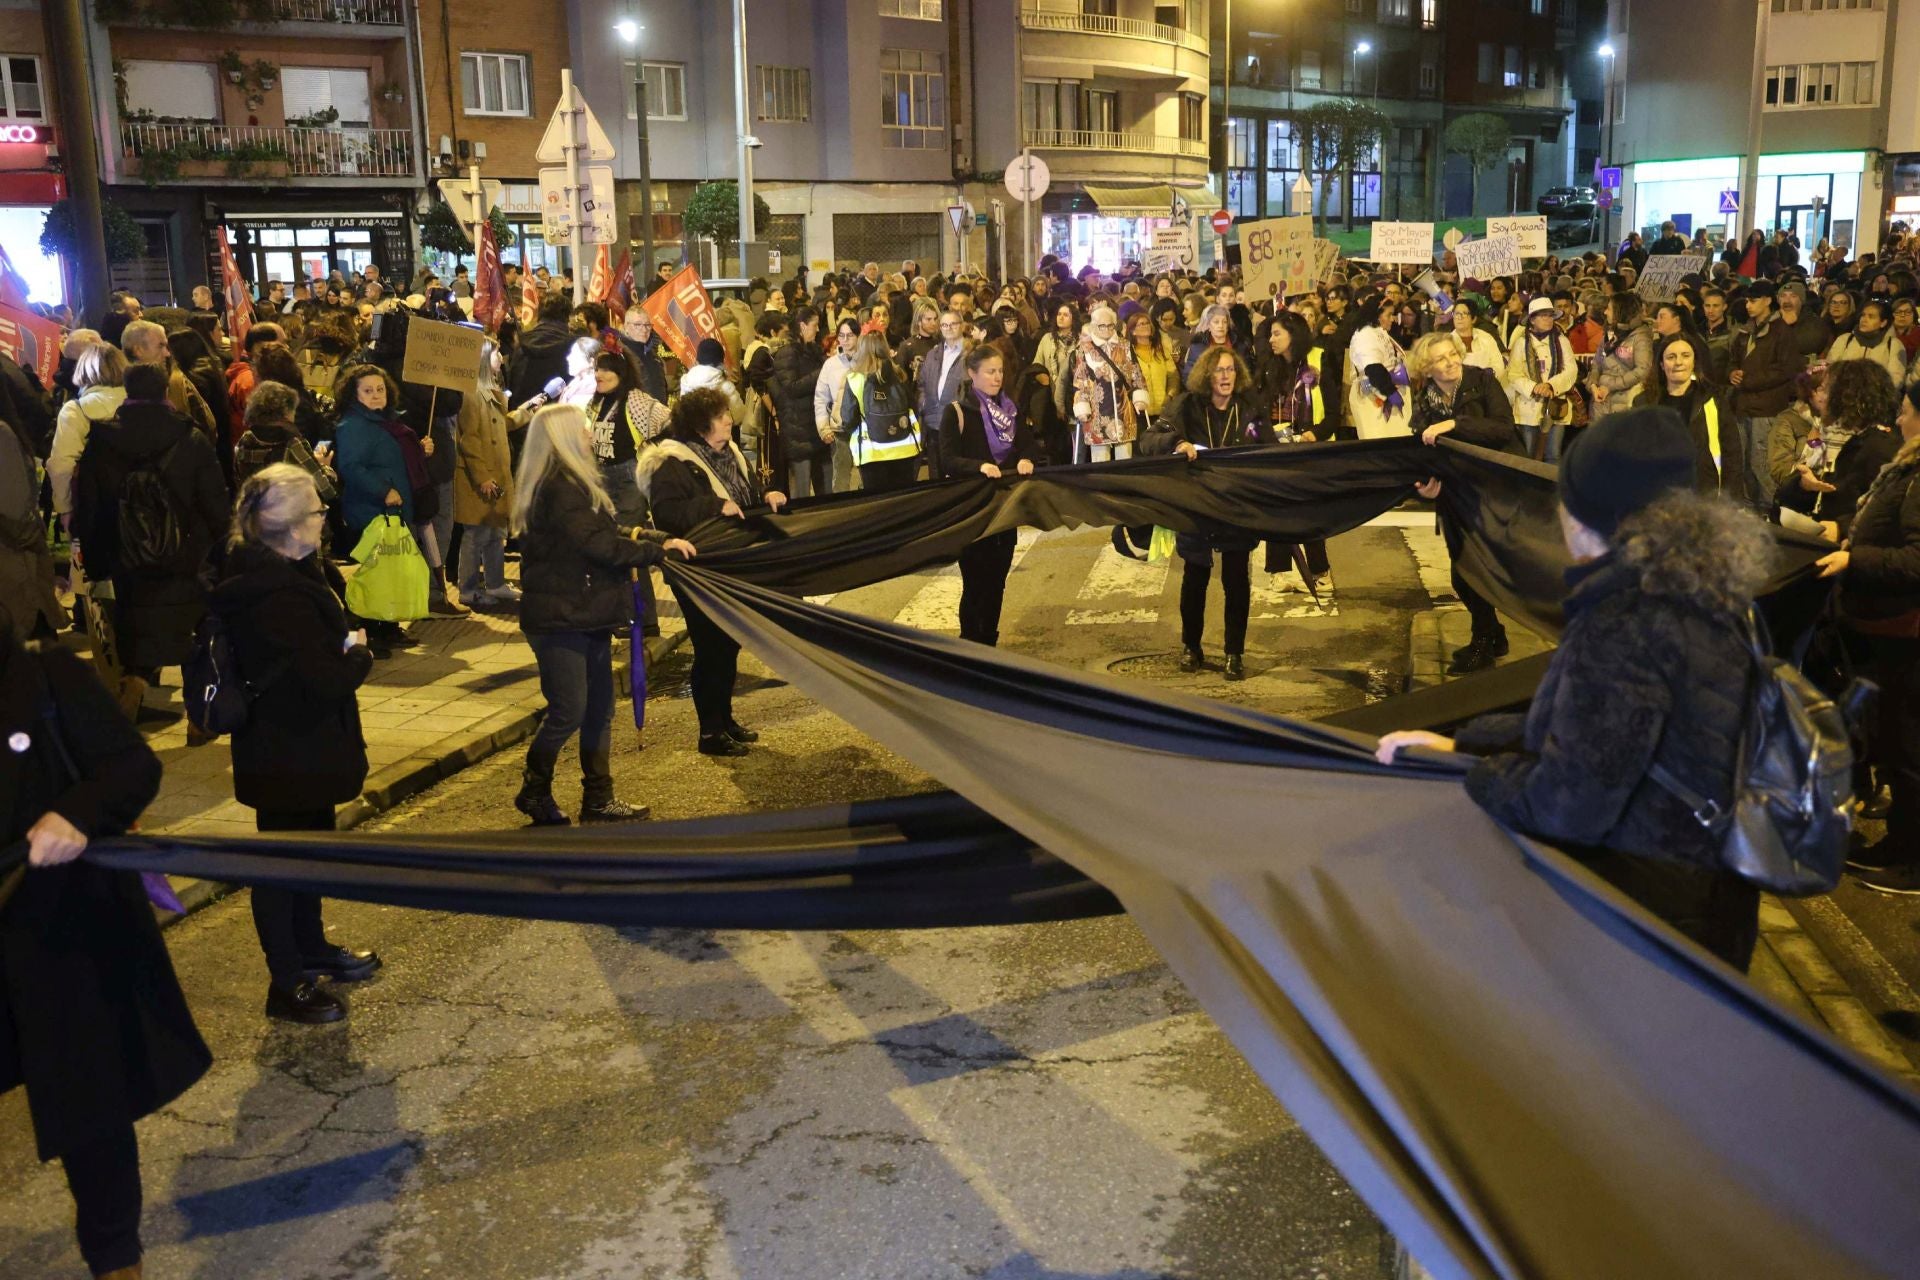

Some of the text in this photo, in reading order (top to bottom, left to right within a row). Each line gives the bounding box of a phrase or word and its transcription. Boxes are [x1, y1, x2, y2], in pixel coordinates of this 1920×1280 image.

[311, 218, 334, 228] CAFÉ
[340, 219, 355, 227] LAS
[1491, 222, 1509, 234] Soy
[1379, 225, 1431, 238] SOY MAYOR
[1385, 237, 1420, 246] QUIERO
[1462, 237, 1515, 255] SOY MAYOR
[1378, 247, 1431, 258] PINTAR ALGO
